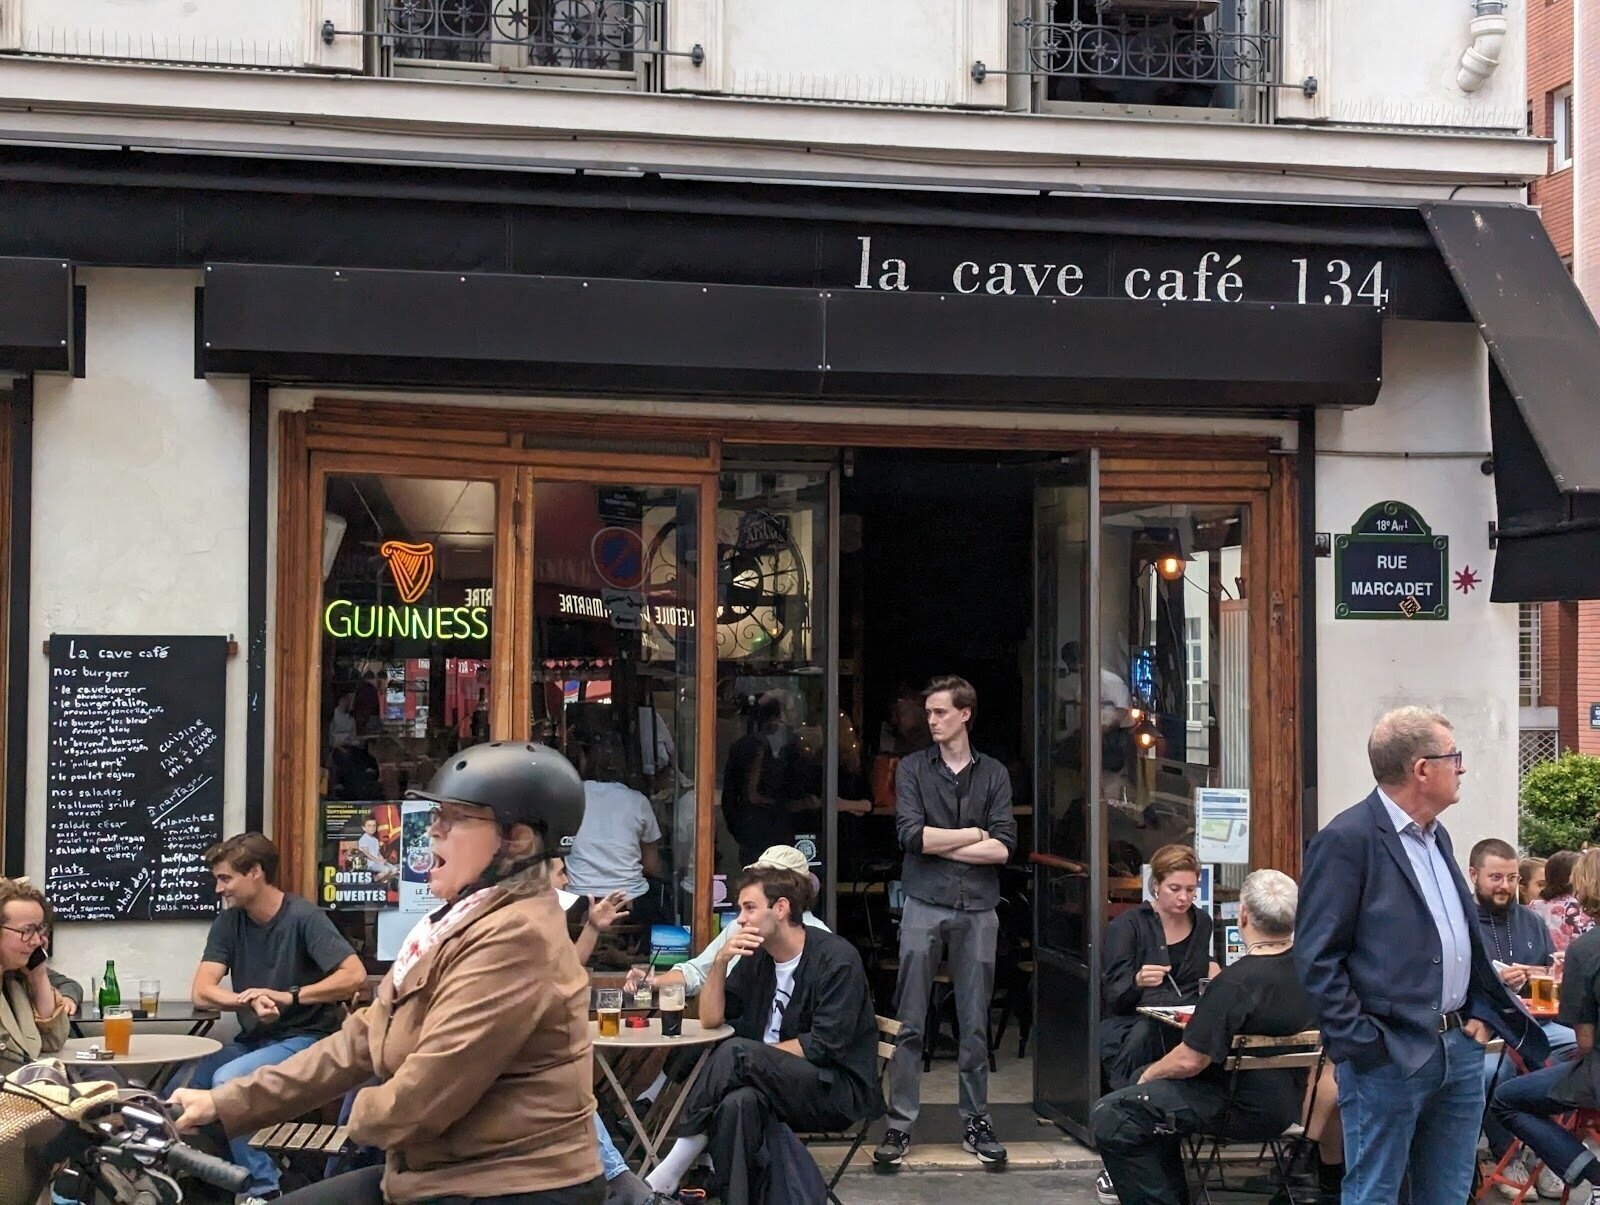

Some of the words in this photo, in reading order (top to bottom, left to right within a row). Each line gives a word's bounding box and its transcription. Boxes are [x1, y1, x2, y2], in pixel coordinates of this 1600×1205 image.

[854, 236, 909, 291] la
[952, 259, 1084, 297] cave
[1124, 251, 1244, 303] café
[1291, 257, 1390, 306] 134
[1377, 555, 1408, 569] RUE
[1351, 582, 1433, 596] MARCADET
[325, 599, 488, 640] GUINNESS
[99, 649, 133, 659] cave
[139, 646, 170, 659] café
[54, 667, 77, 676] nos
[82, 666, 130, 682] burgers
[61, 685, 71, 694] le
[61, 700, 71, 708] le
[75, 699, 111, 710] burger
[59, 719, 68, 727] le
[71, 719, 105, 728] burger
[59, 737, 68, 746] le
[111, 737, 143, 746] burger
[160, 719, 204, 753] cuisine
[71, 771, 104, 782] poulet
[107, 768, 135, 781] cajun
[52, 789, 74, 797] nos
[79, 788, 122, 797] salades
[58, 800, 104, 809] halloumi
[58, 820, 90, 829] salade
[160, 813, 215, 829] planches
[106, 853, 137, 861] quercy
[51, 863, 84, 876] plats
[324, 866, 372, 884] PORTES
[117, 887, 133, 905] hot
[131, 867, 149, 888] dog
[160, 878, 199, 889] frites
[52, 892, 105, 903] tartares
[324, 884, 387, 902] OUVERTES
[155, 903, 179, 912] salsa
